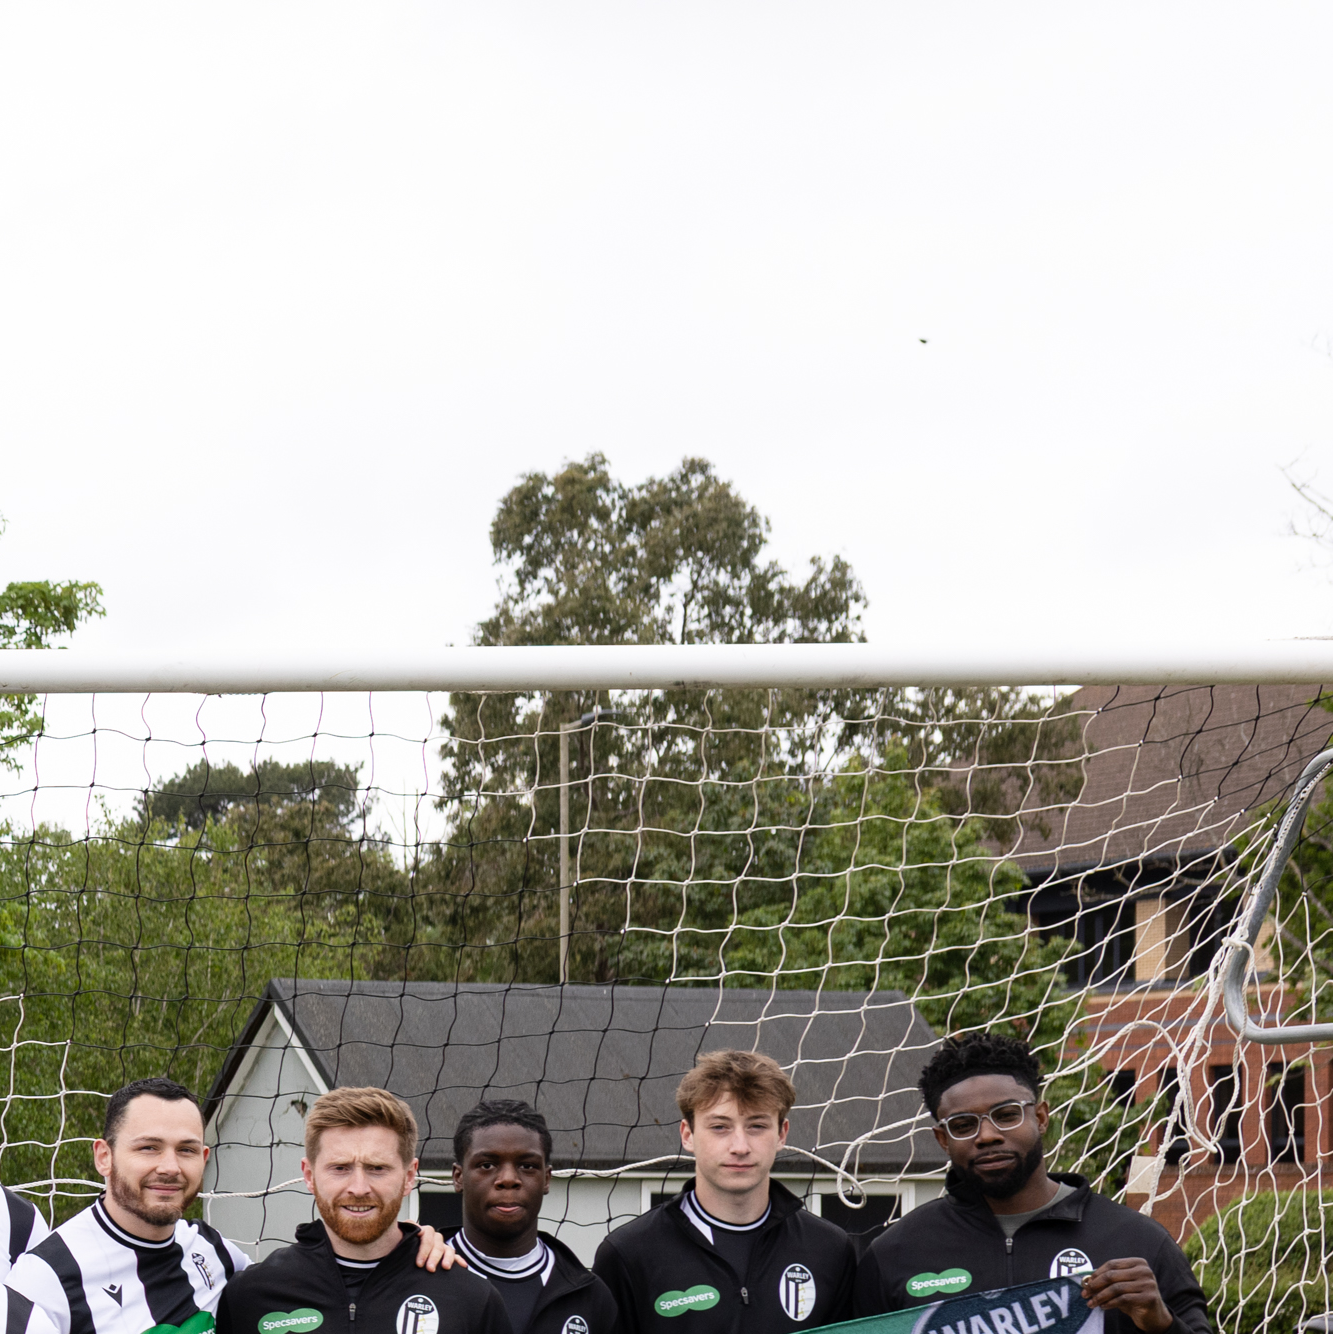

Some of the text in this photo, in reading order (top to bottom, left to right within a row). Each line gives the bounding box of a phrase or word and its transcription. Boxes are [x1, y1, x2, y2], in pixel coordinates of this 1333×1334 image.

[911, 1276, 966, 1290] Specsavers
[407, 1302, 432, 1311] WARLEY
[659, 1292, 715, 1310] Specsavers
[263, 1316, 317, 1330] Specsavers
